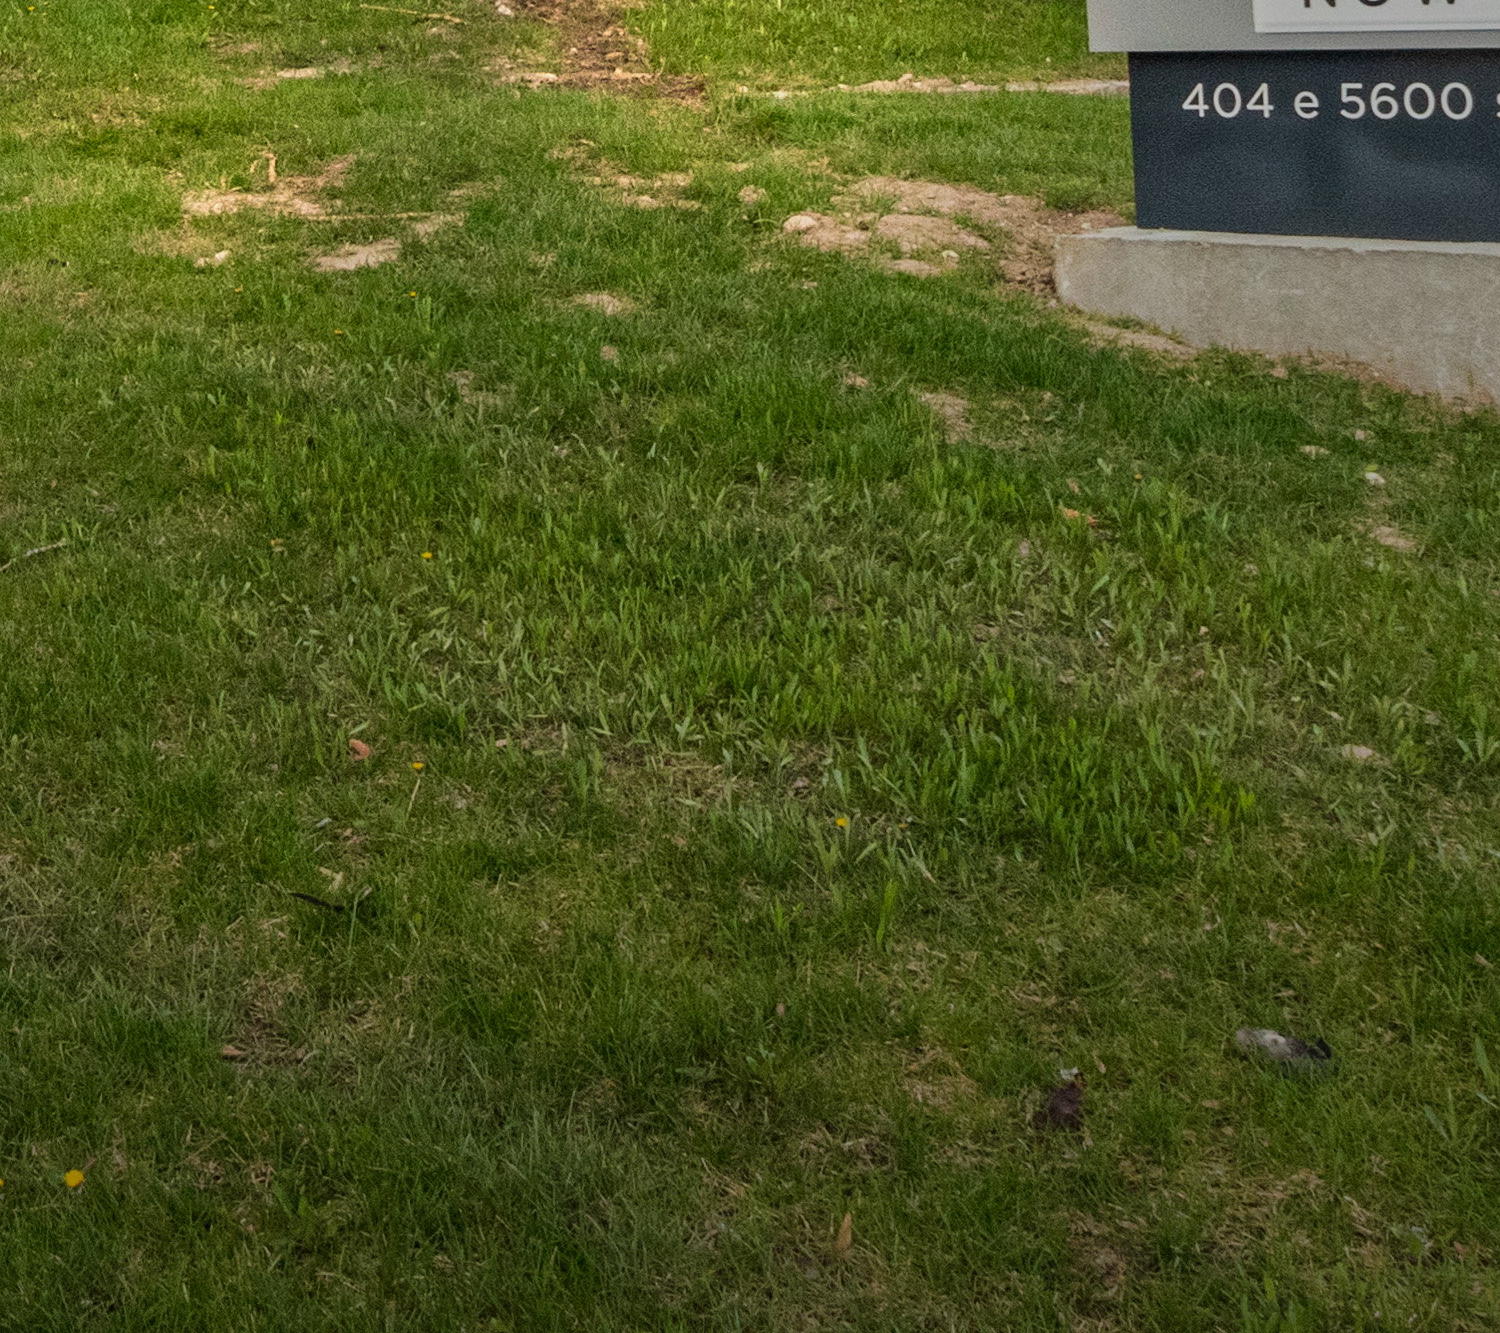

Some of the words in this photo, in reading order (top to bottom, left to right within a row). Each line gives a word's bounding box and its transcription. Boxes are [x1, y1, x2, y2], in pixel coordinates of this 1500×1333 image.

[1181, 81, 1275, 119] 404
[1292, 90, 1320, 120] e
[1339, 81, 1474, 121] 5600
